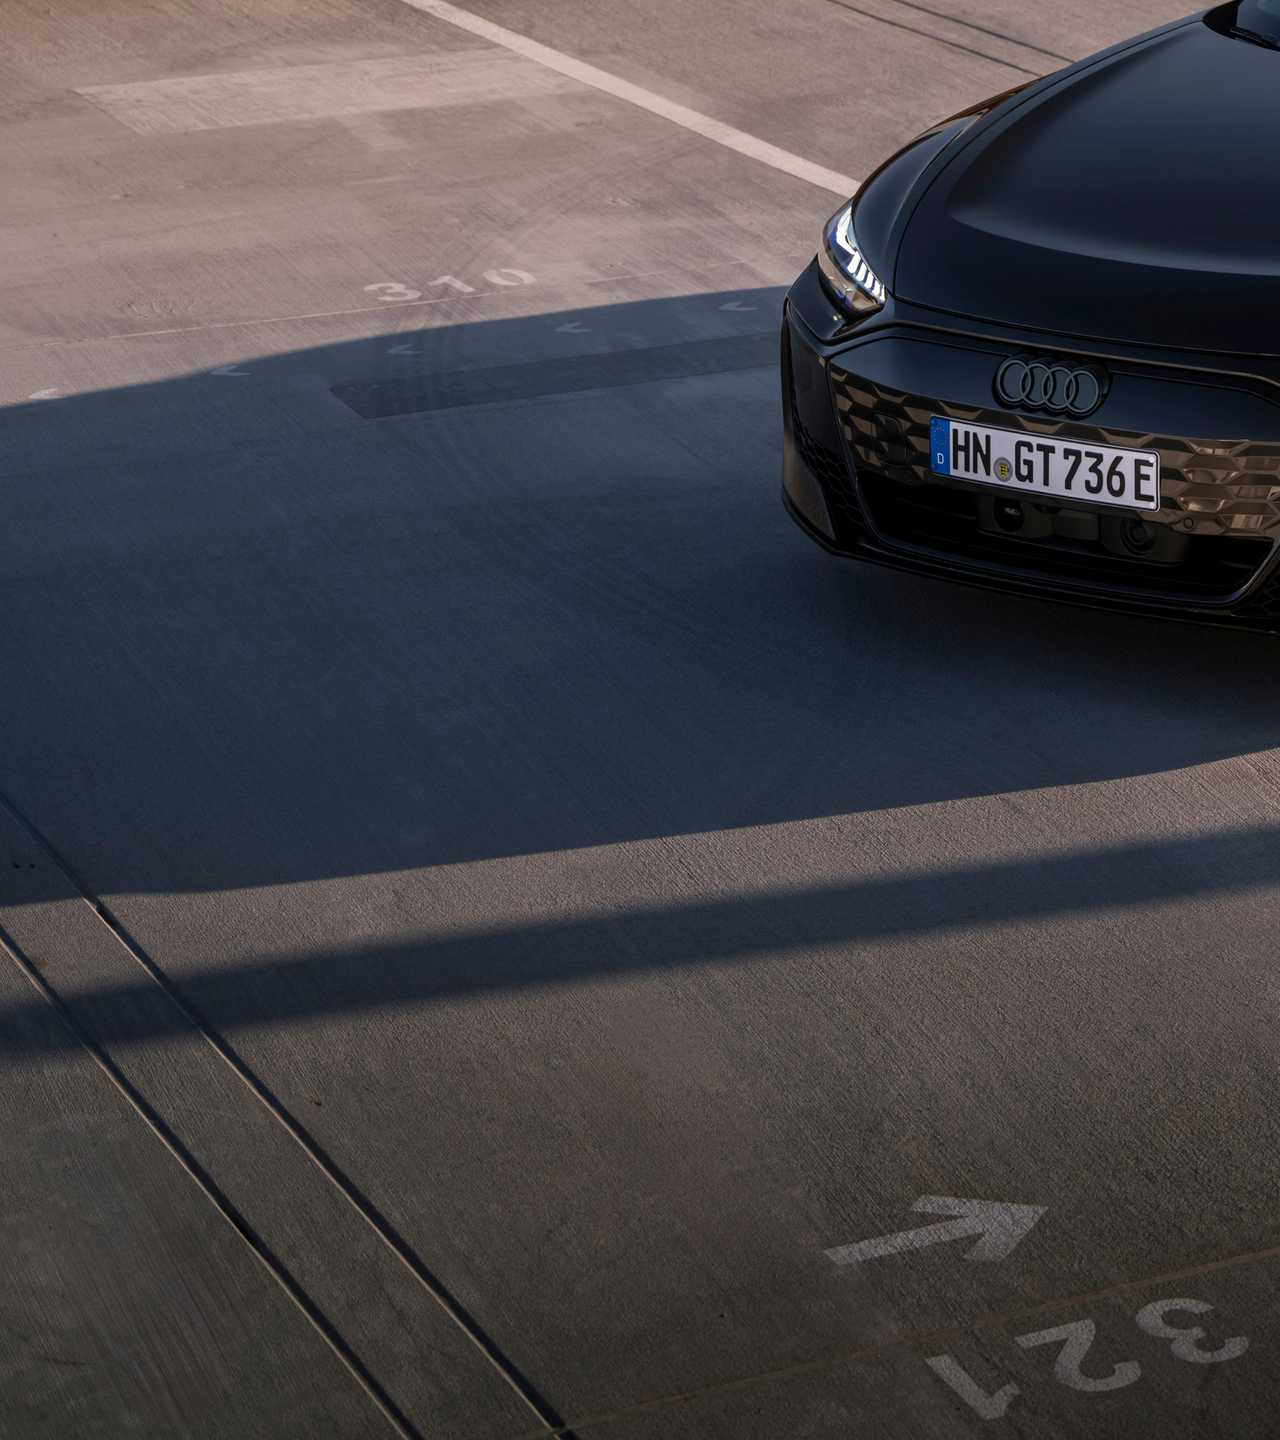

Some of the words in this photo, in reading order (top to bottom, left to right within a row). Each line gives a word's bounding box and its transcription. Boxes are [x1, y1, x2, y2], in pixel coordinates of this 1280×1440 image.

[364, 267, 538, 301] 310
[937, 452, 944, 465] D
[952, 428, 991, 477] HN
[1014, 440, 1056, 487] GT
[924, 1297, 1250, 1421] 321
